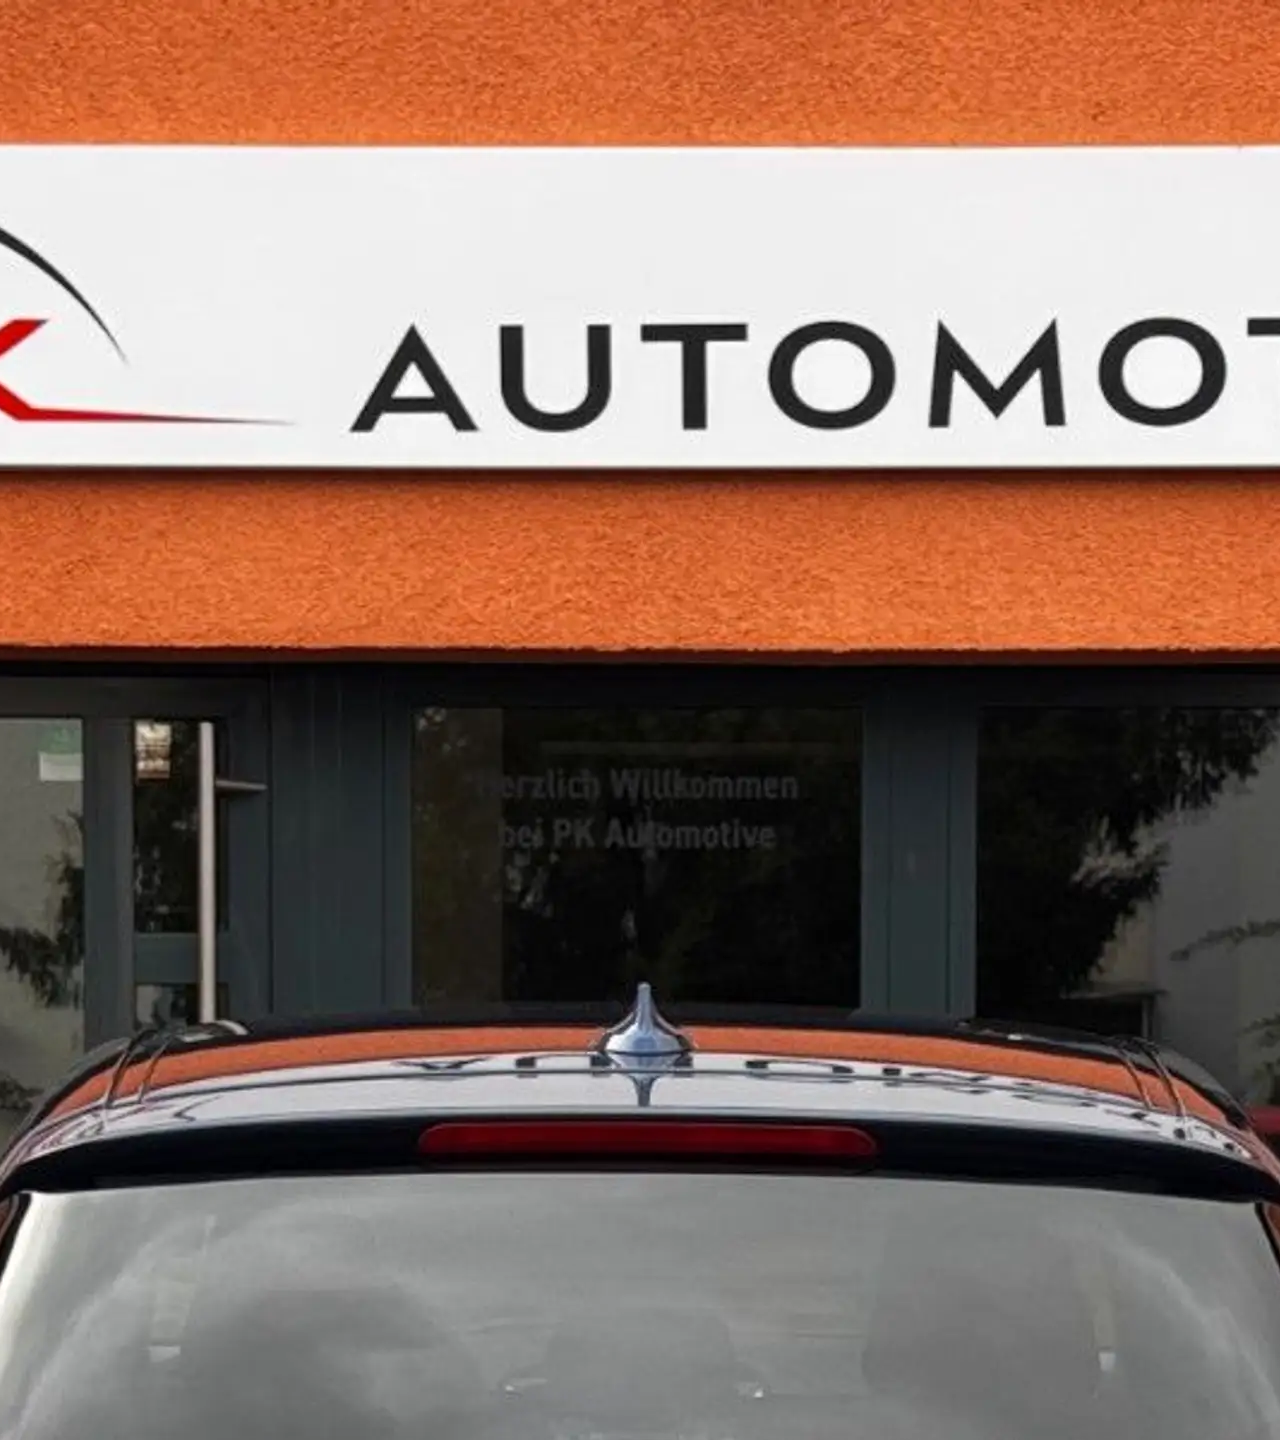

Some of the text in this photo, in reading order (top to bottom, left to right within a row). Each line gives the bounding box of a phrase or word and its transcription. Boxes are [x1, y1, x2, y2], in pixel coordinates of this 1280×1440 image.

[610, 768, 799, 800] Willkommen
[553, 818, 595, 849] PK
[605, 818, 776, 849] Automotive
